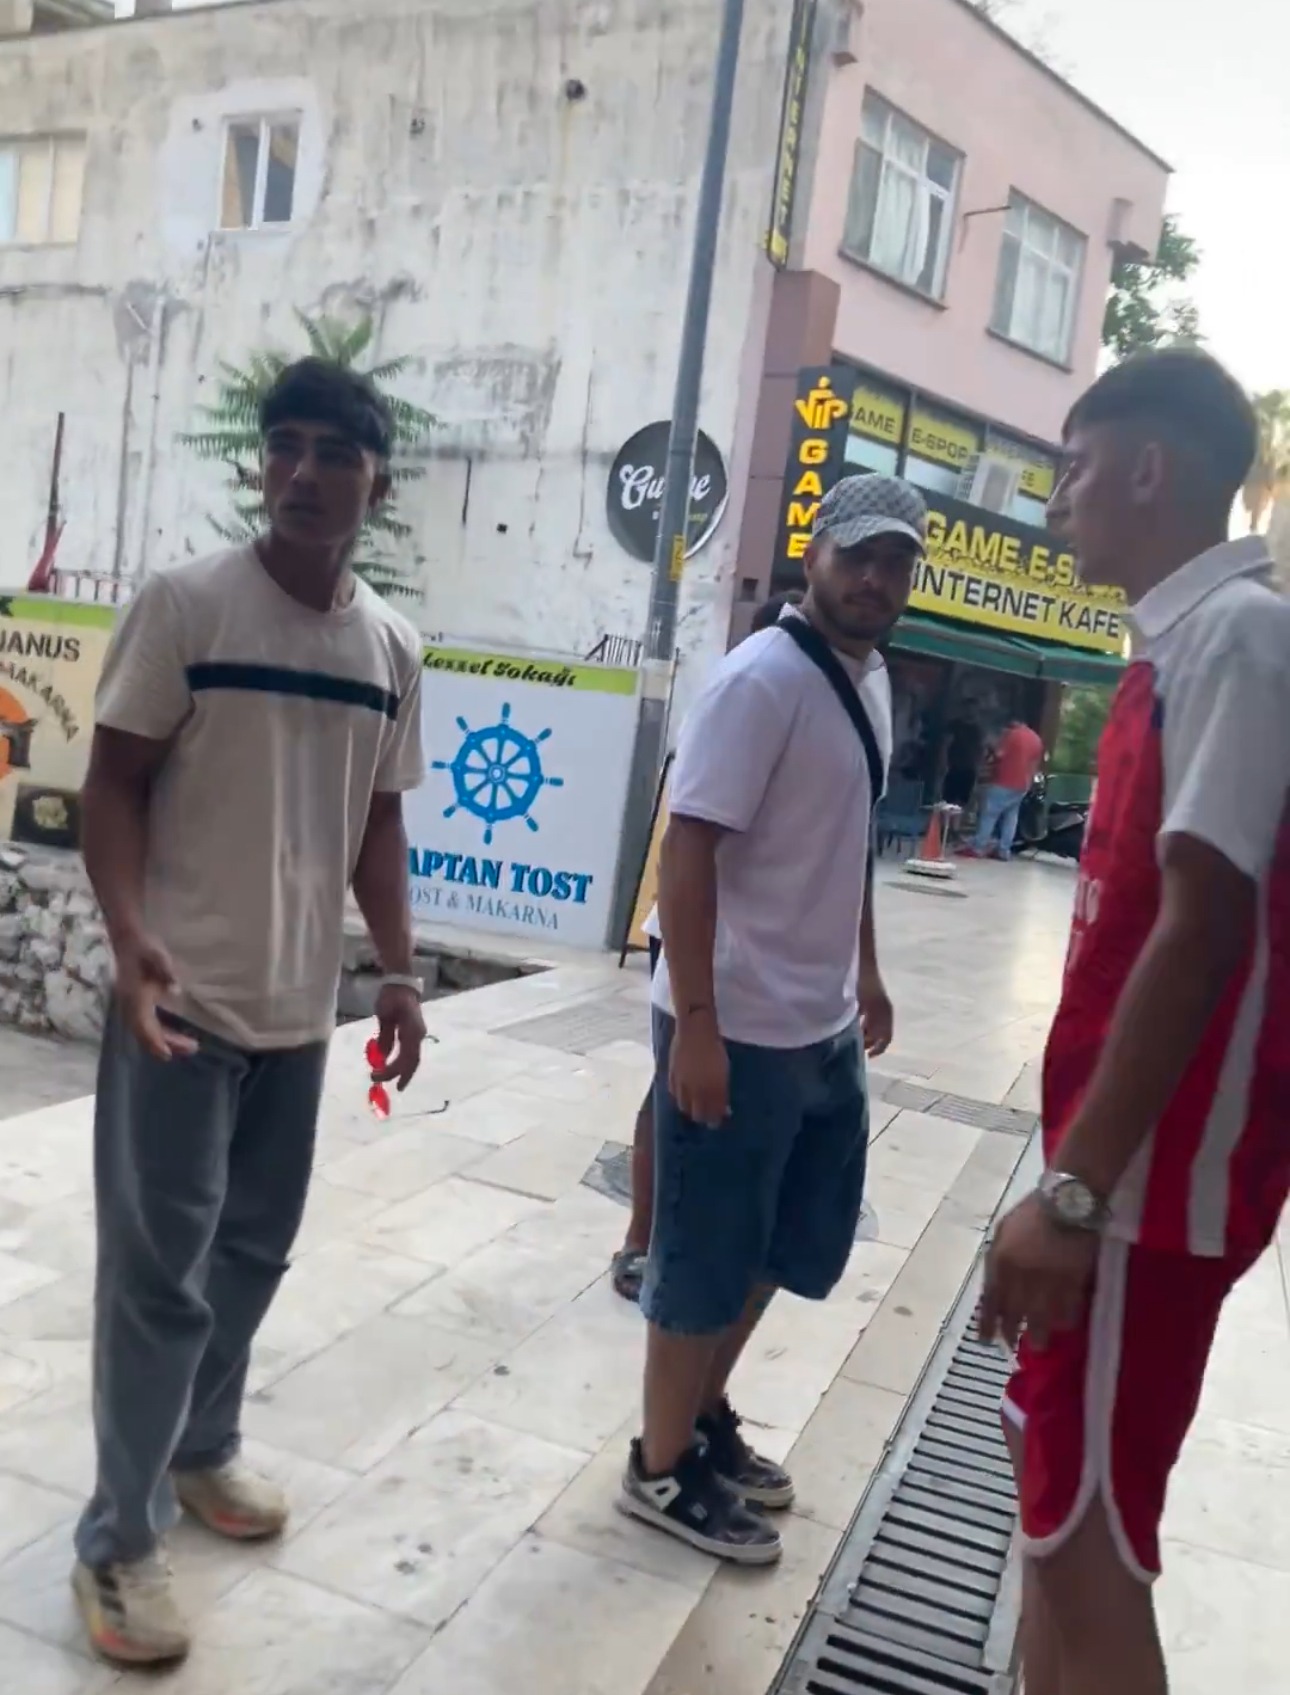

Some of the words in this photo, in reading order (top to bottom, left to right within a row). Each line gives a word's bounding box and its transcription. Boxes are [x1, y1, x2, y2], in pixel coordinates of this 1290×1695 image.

[786, 438, 829, 559] GAME
[924, 510, 1022, 571] GAME
[912, 560, 1056, 624] INTERNET
[1058, 600, 1120, 639] KAFE
[408, 847, 504, 889] APTAN
[510, 862, 594, 905] TOST
[409, 886, 444, 906] OST
[447, 892, 461, 909] &
[465, 893, 560, 930] MAKARNA
